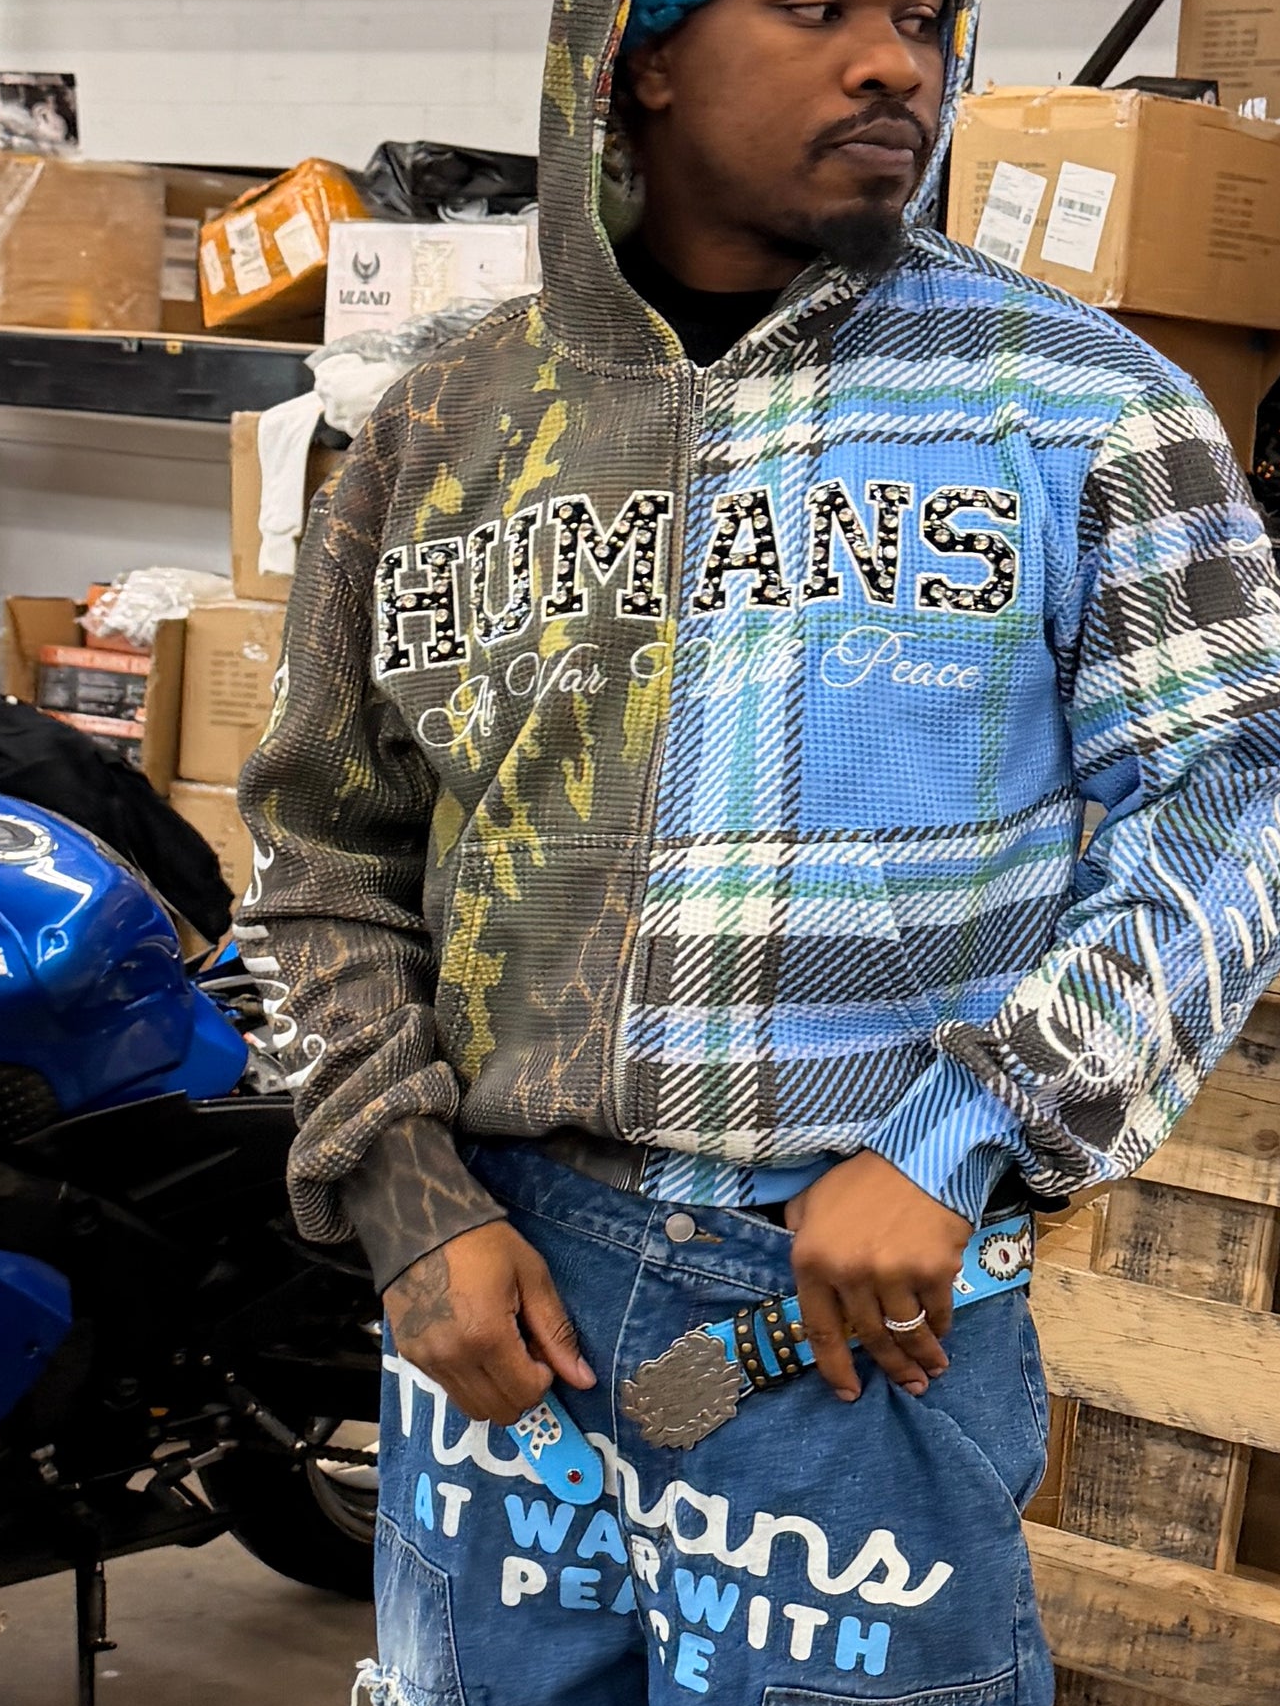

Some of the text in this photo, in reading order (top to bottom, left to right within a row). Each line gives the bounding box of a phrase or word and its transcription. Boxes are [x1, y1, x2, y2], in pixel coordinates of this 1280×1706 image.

[375, 478, 1021, 681] HUMANS
[821, 624, 984, 689] Peace
[414, 1471, 892, 1677] AT WAR WITH
